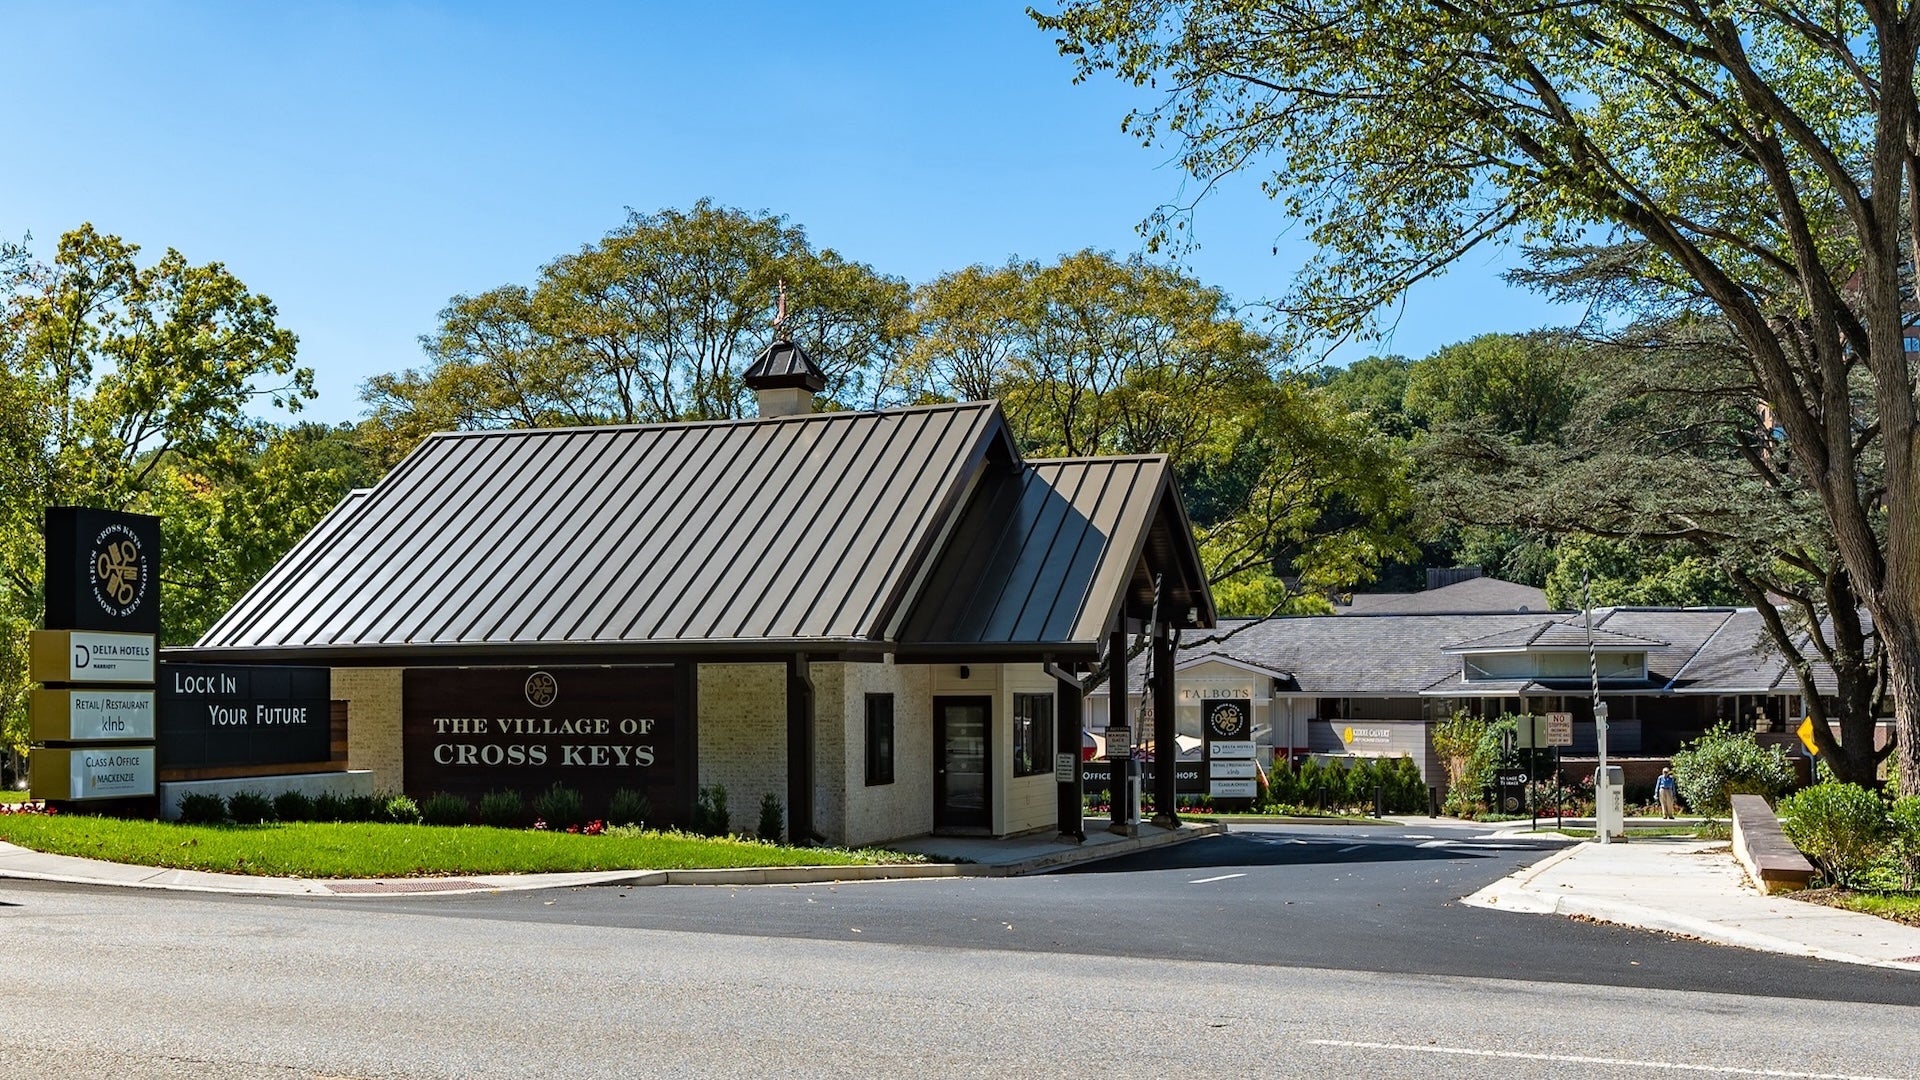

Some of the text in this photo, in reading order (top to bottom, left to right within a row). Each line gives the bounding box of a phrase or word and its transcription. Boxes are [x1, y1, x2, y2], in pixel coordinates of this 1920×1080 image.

[96, 524, 142, 550] CROSS KEYS
[92, 644, 150, 656] DELTA HOTELS
[1182, 689, 1249, 699] TALBOTS
[75, 698, 100, 710] RETAIL
[105, 698, 149, 710] RESTAURANT
[102, 715, 125, 731] klnb
[1553, 715, 1565, 723] NO
[433, 718, 655, 735] THE VILLAGE OF
[433, 743, 655, 767] CROSS KEYS
[85, 755, 140, 768] CLASS A OFFICE
[97, 773, 135, 783] MACKENZIE
[1082, 771, 1111, 781] OFFICE
